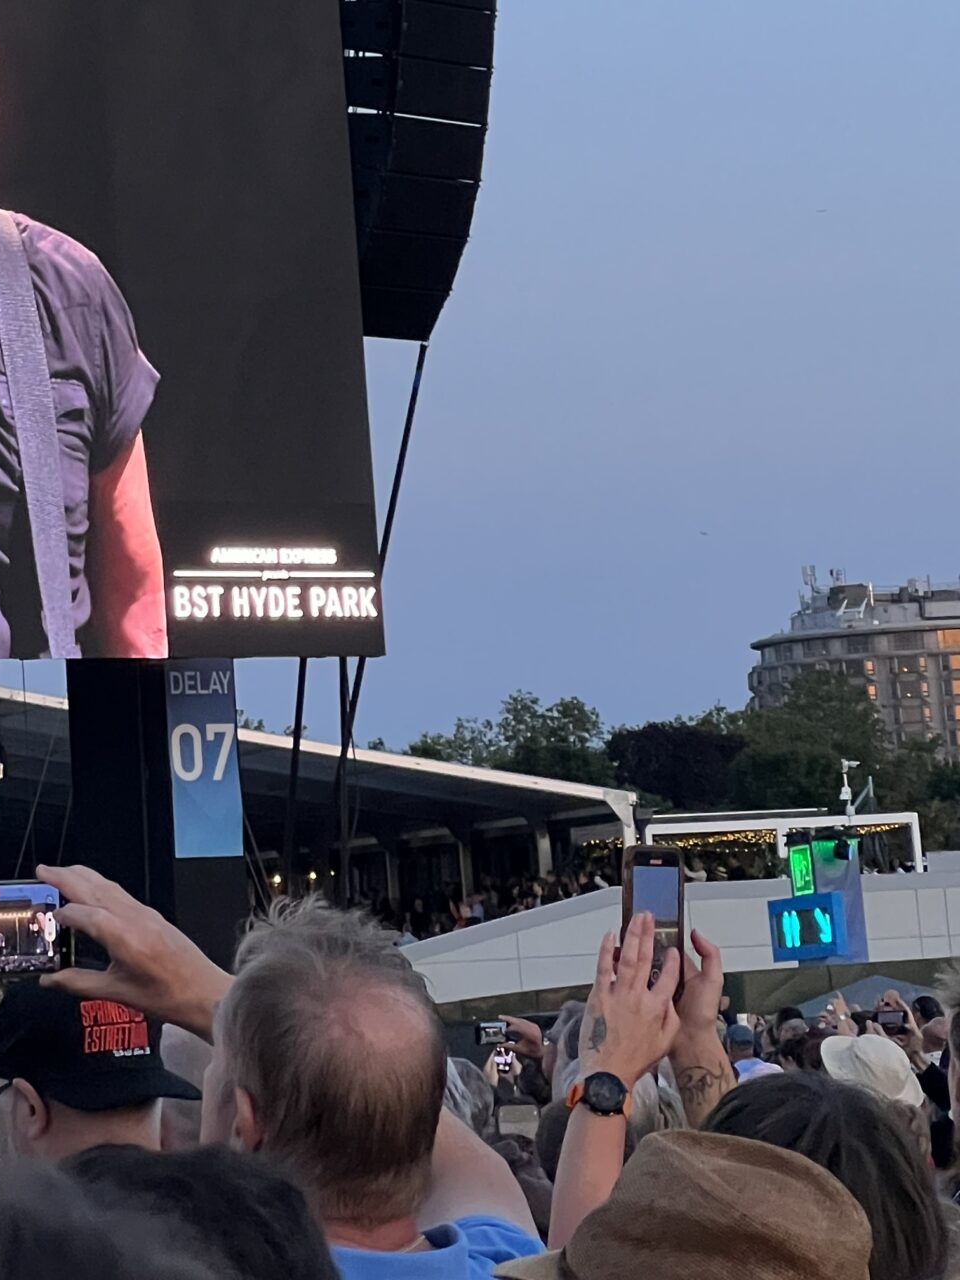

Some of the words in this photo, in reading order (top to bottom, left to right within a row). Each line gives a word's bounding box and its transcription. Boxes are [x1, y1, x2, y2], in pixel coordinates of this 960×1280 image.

[173, 585, 224, 618] BST
[231, 586, 303, 618] HYDE
[309, 586, 378, 618] PARK
[169, 670, 231, 695] DELAY
[171, 723, 235, 782] 07
